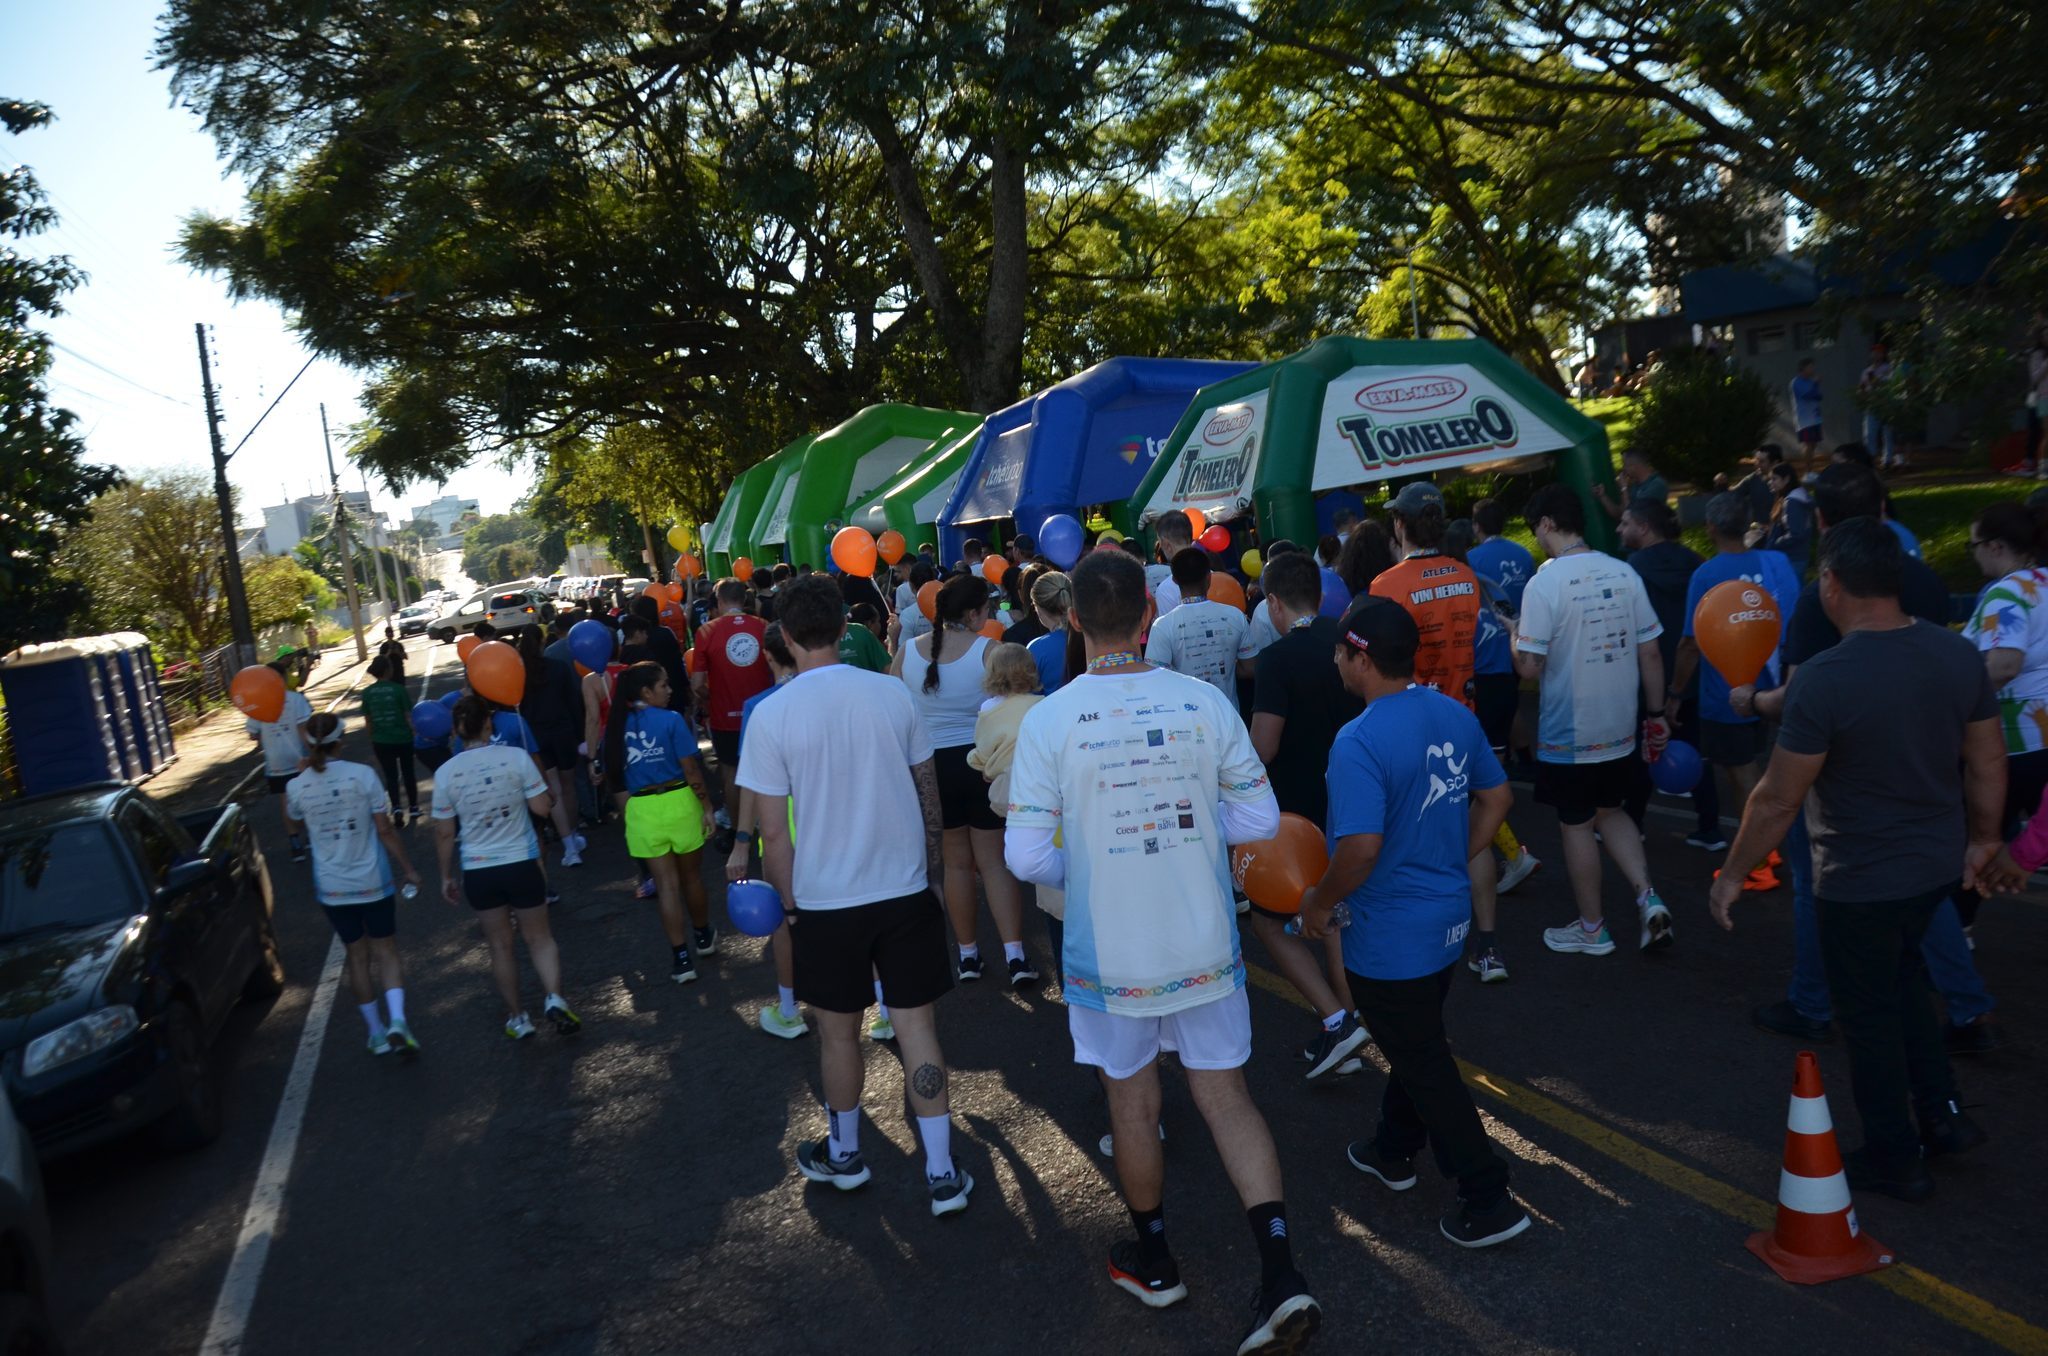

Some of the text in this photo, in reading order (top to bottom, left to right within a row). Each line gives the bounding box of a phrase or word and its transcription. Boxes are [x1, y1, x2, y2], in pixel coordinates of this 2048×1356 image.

[1366, 381, 1457, 406] ERVA-MATE
[1339, 398, 1516, 465] TOMELERO
[1176, 434, 1257, 496] TOMELERO
[1422, 566, 1460, 579] ATLETA
